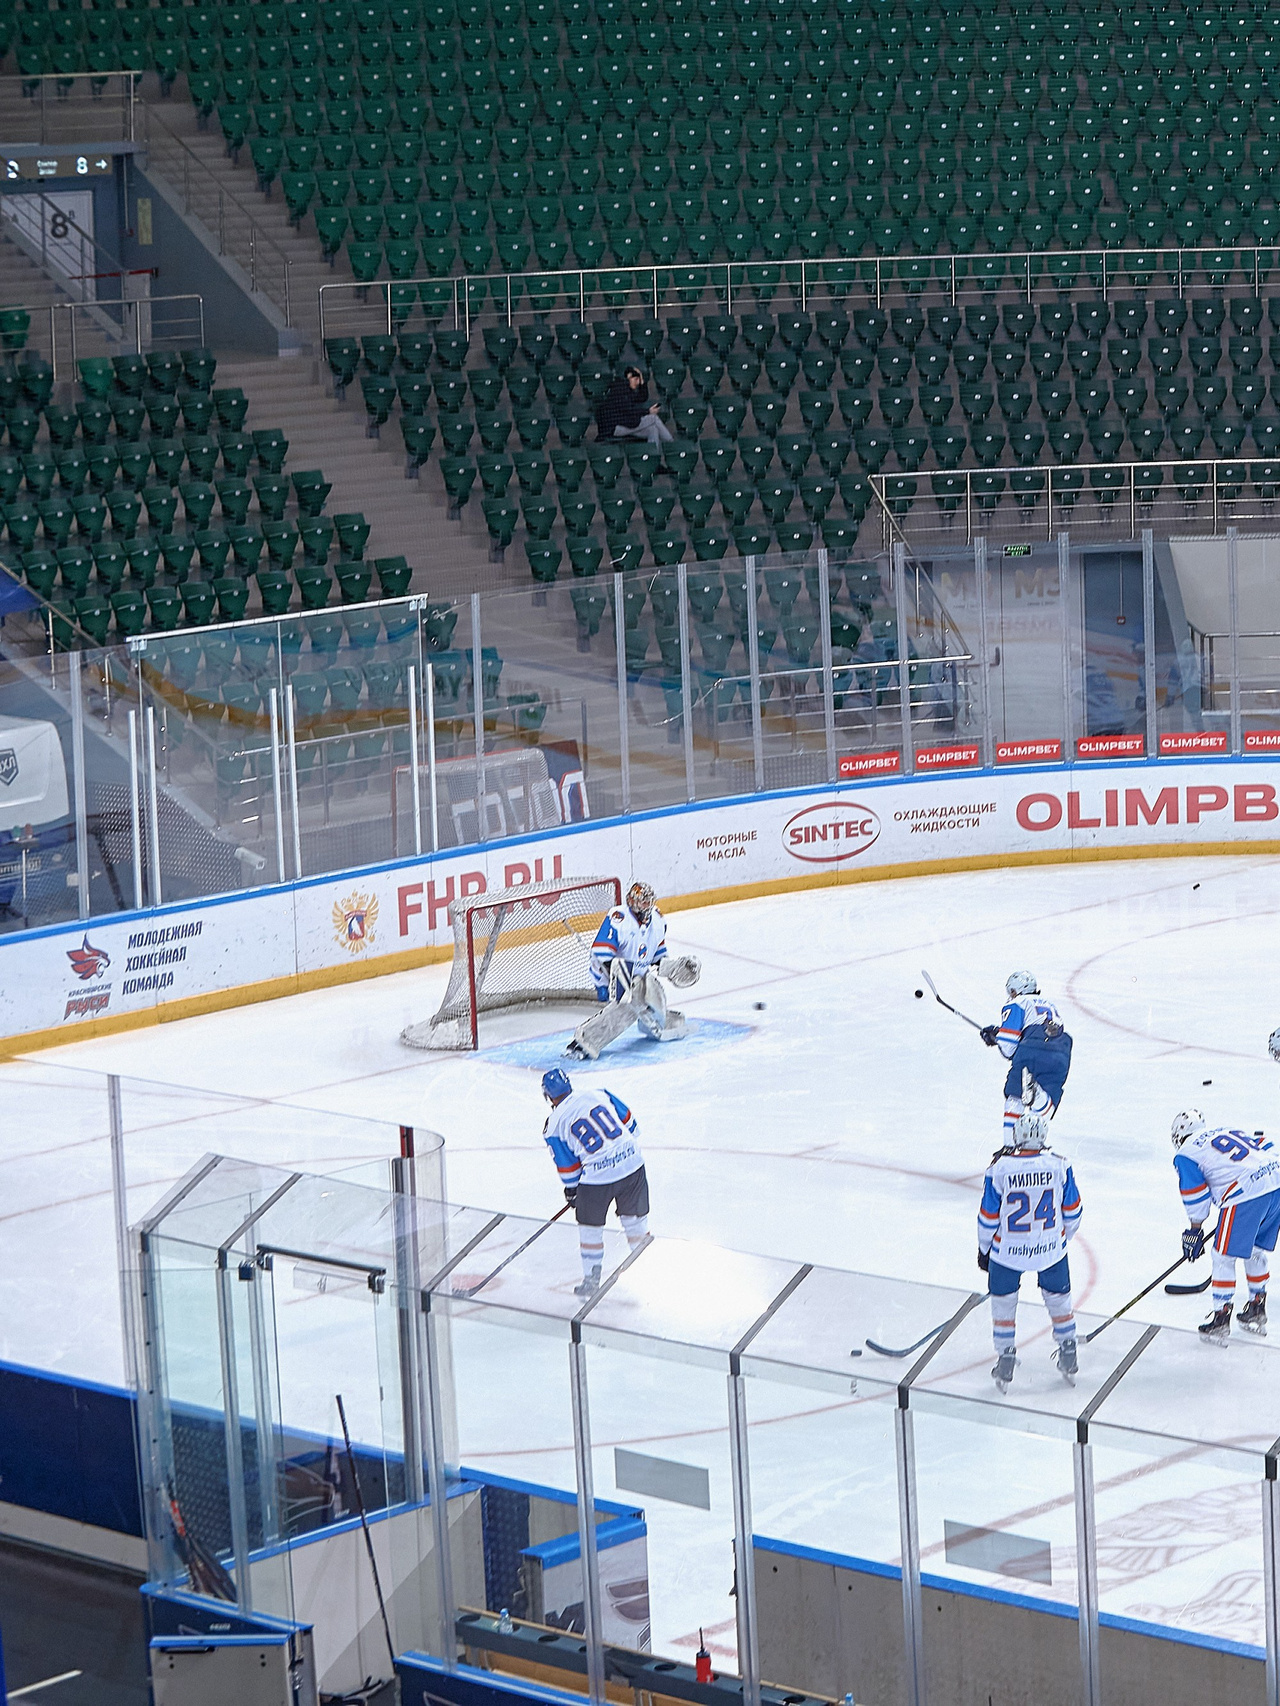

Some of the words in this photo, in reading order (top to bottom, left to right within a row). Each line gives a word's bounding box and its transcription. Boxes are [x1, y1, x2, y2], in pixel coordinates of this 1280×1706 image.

[76, 156, 88, 174] 8
[998, 744, 1059, 758] OLIMPBET
[1079, 740, 1142, 752] OLIMPBET
[1161, 736, 1225, 749] OLIMPBET
[840, 756, 899, 772] OLIMPBET
[917, 750, 977, 764] OLIMPBET
[894, 802, 997, 822] ОХЛАЖДАЮЩИЕ
[789, 818, 874, 846] SINTEC
[910, 817, 980, 834] ЖИДКОСТИ
[696, 830, 758, 850] МОТОРНЫЕ
[708, 845, 746, 862] МАСЛА
[127, 921, 203, 950] МОЛОДЕЖНАЯ
[125, 945, 187, 973] ХОККЕЙНАЯ
[122, 971, 174, 996] КОМАНДА
[571, 1104, 622, 1155] 80
[1007, 1171, 1053, 1189] МИЛЛЕР
[1006, 1188, 1057, 1233] 24
[1007, 1240, 1057, 1259] rushydro.ru
